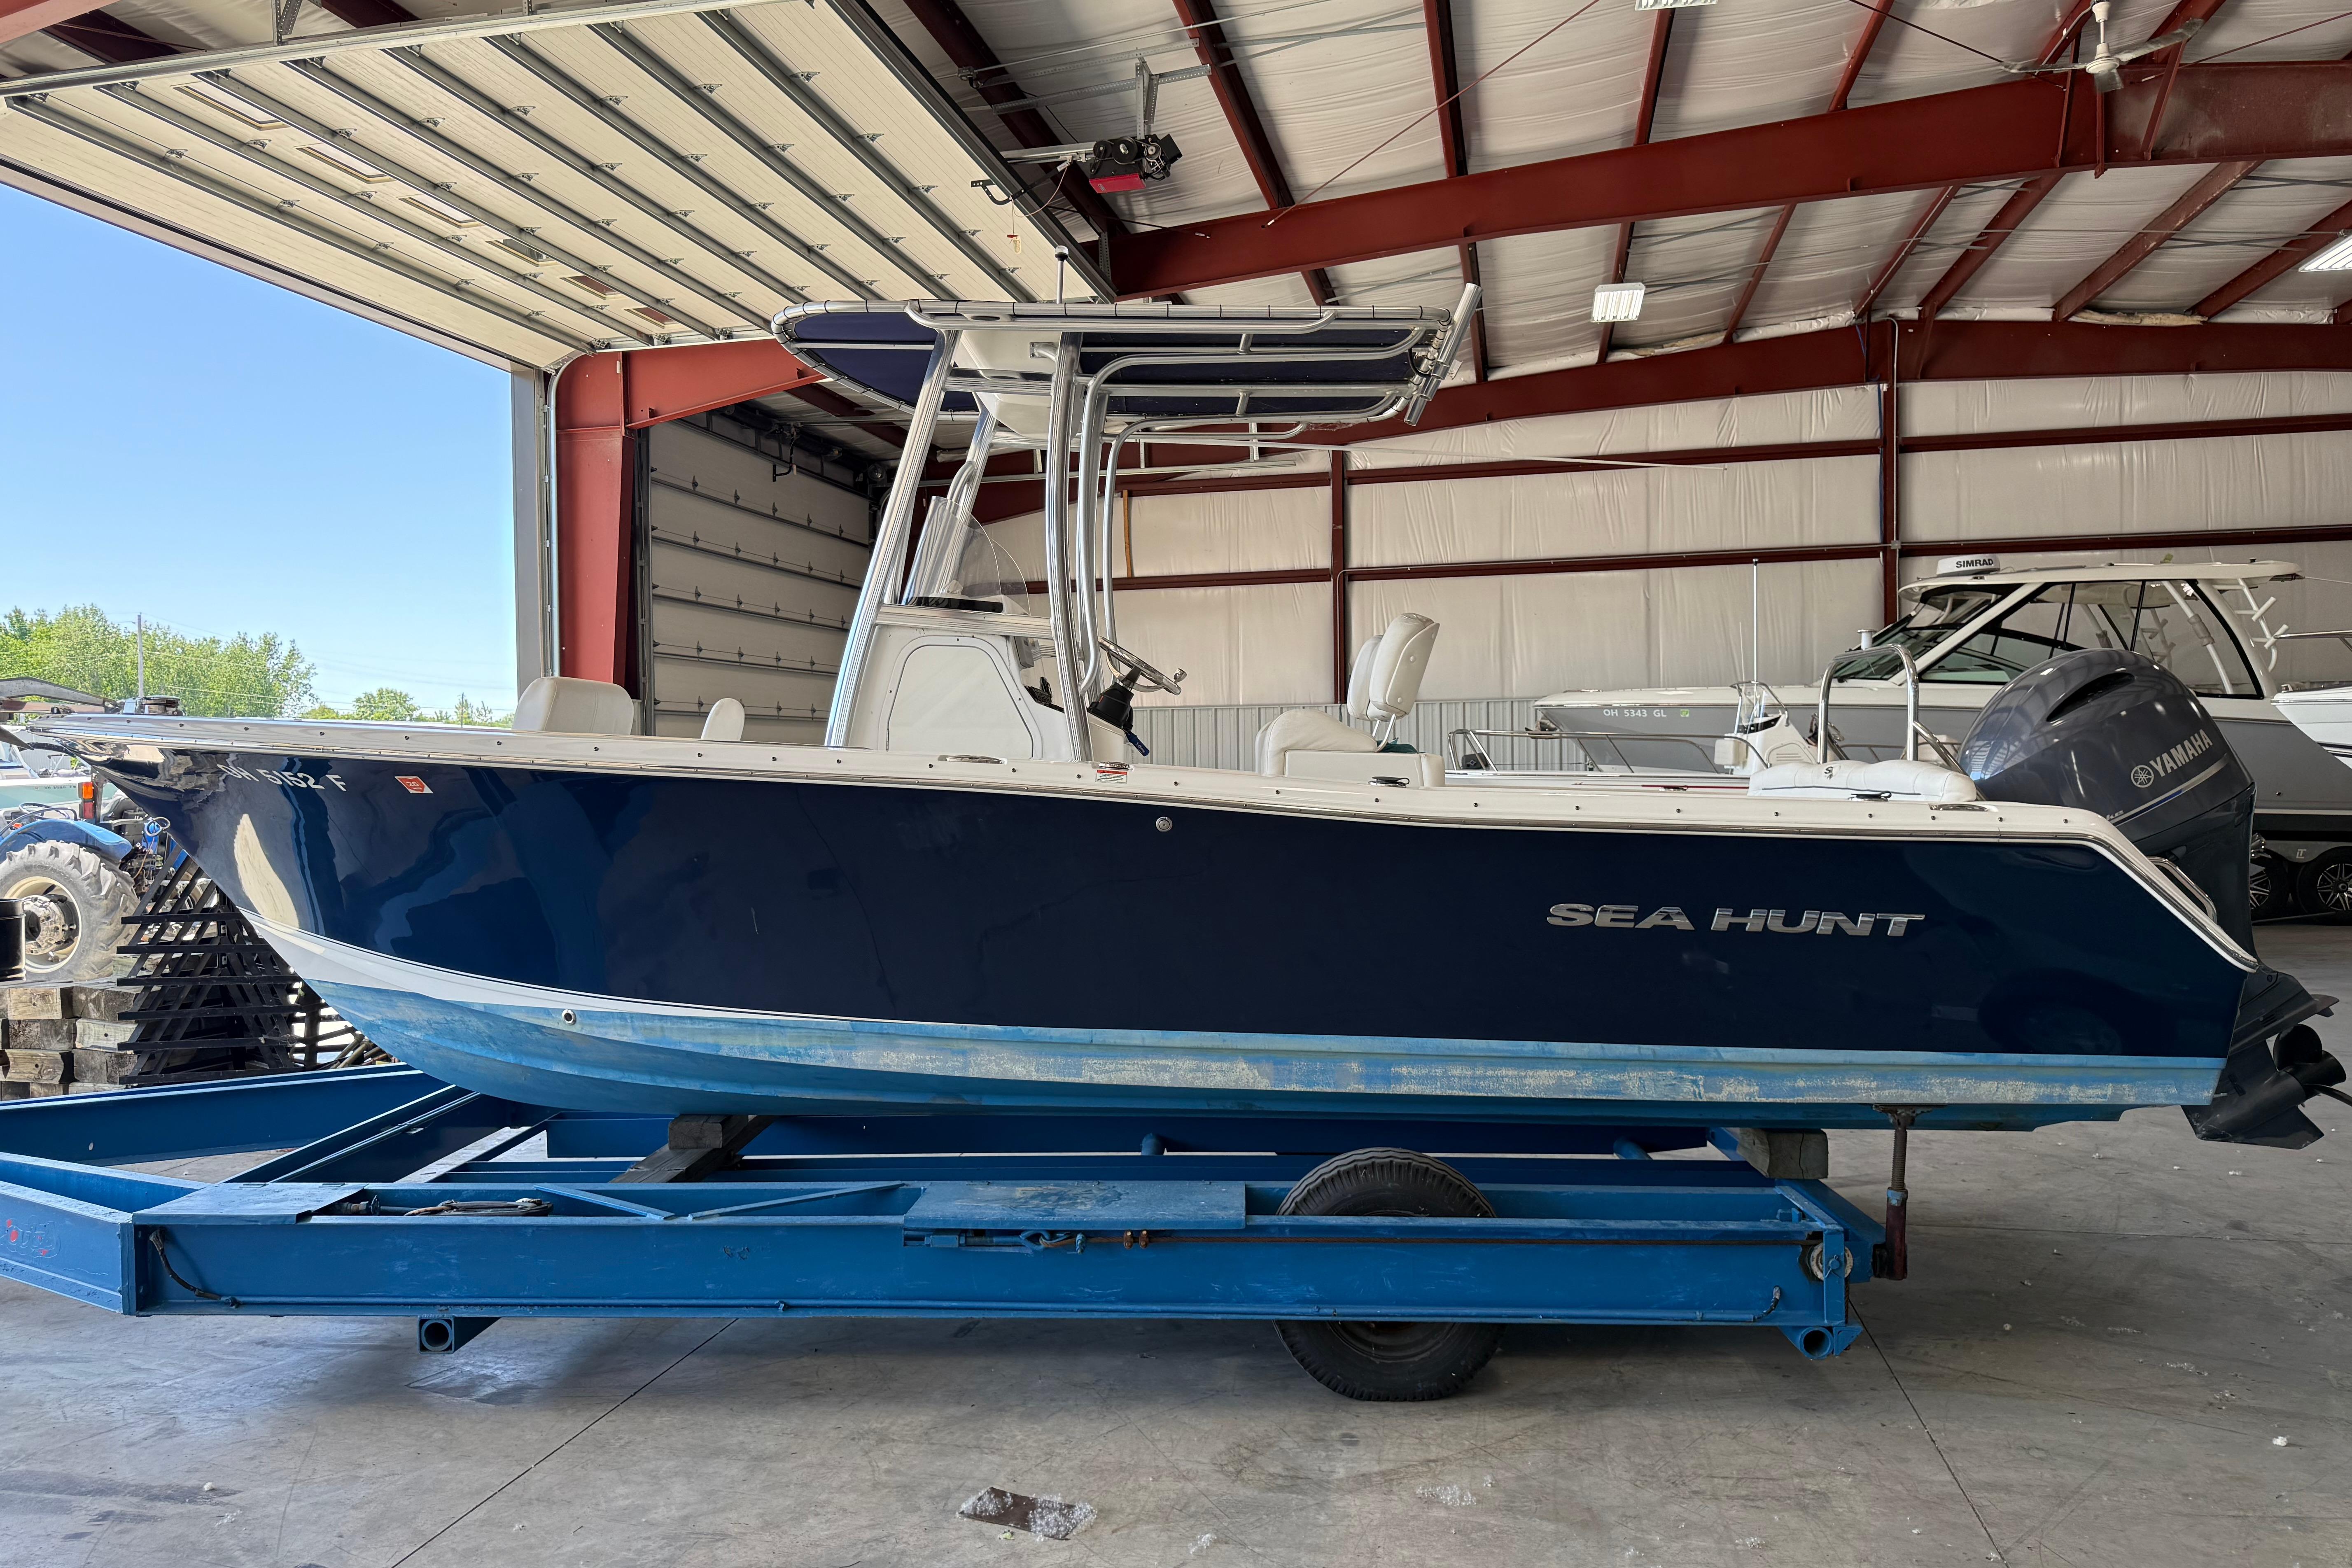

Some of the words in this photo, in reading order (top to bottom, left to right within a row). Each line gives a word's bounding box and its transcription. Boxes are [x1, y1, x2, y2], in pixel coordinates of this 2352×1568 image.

[1956, 559, 1993, 568] SIMRAD
[2149, 729, 2213, 777] YAMAHA
[217, 764, 259, 782] OH
[256, 769, 325, 789] 5152
[326, 775, 346, 791] F
[1547, 903, 1695, 930] SEA
[1711, 908, 1925, 936] HUNT
